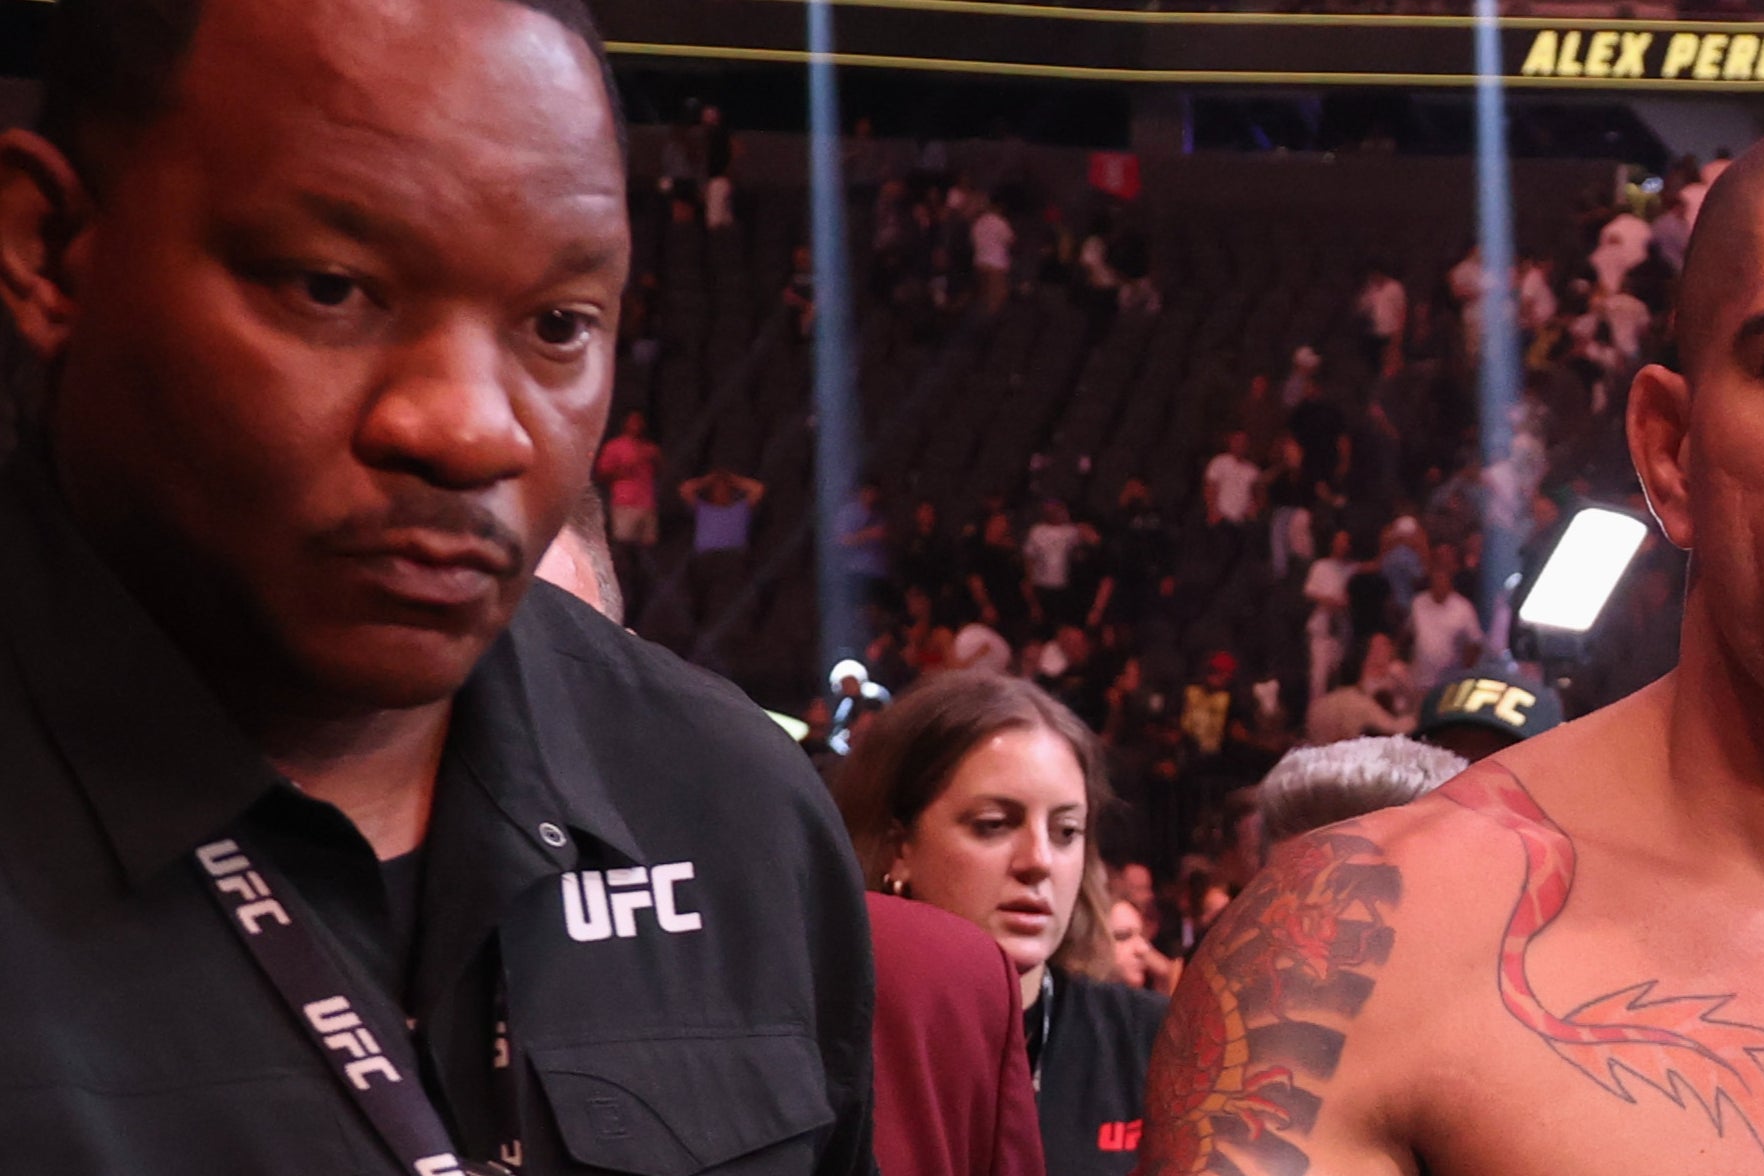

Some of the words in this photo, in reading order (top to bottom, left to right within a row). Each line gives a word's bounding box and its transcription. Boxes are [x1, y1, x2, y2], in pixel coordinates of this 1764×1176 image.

[1522, 30, 1652, 77] ALEX
[196, 838, 291, 934] UFC
[561, 861, 702, 942] UFC
[303, 995, 402, 1091] UFC
[1097, 1118, 1143, 1151] UF
